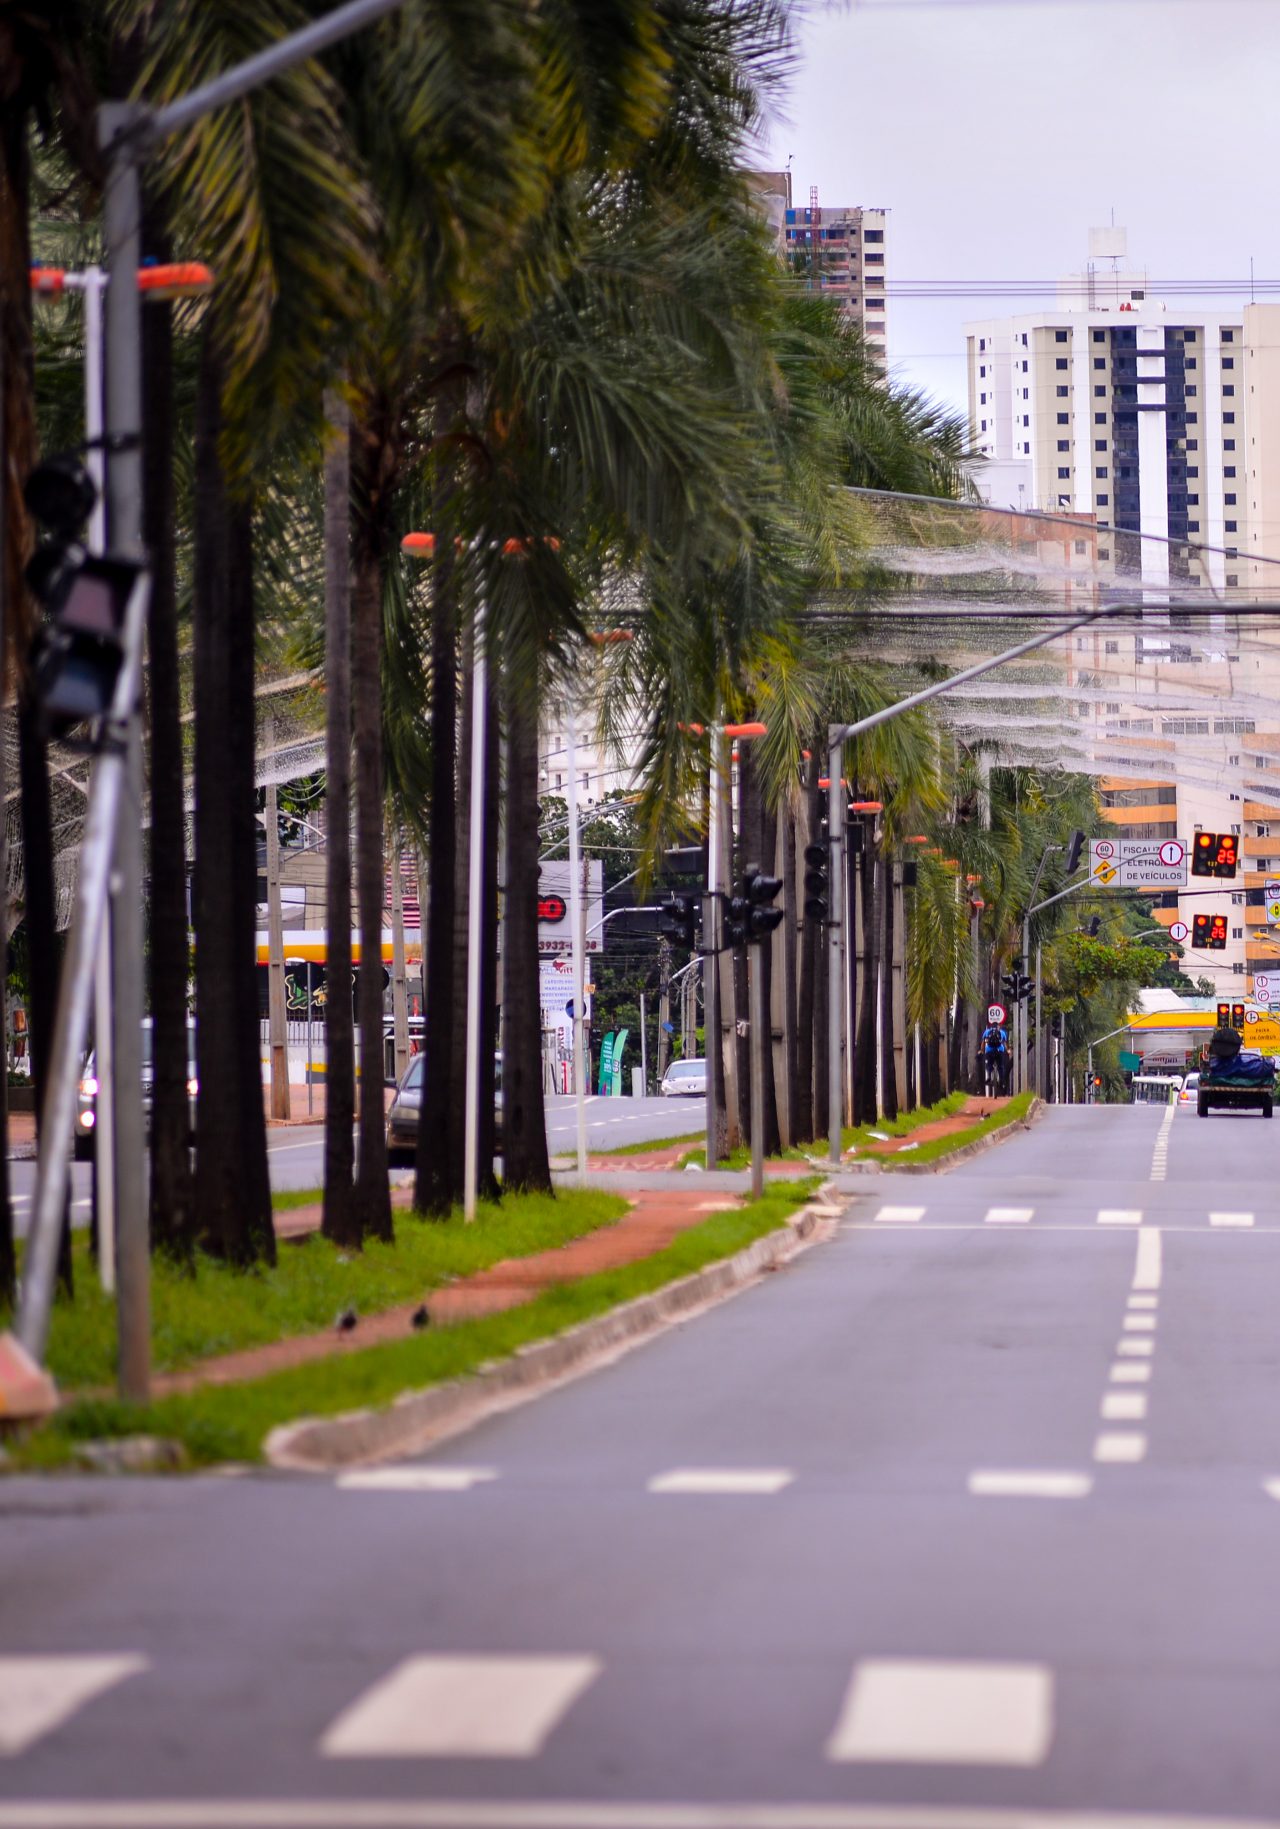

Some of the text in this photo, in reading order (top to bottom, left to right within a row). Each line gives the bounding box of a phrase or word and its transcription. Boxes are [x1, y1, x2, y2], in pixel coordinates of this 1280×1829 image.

[1217, 849, 1236, 864] 25
[1140, 871, 1182, 880] VEÍCULOS
[1211, 927, 1225, 939] 25
[990, 1008, 1001, 1016] 60
